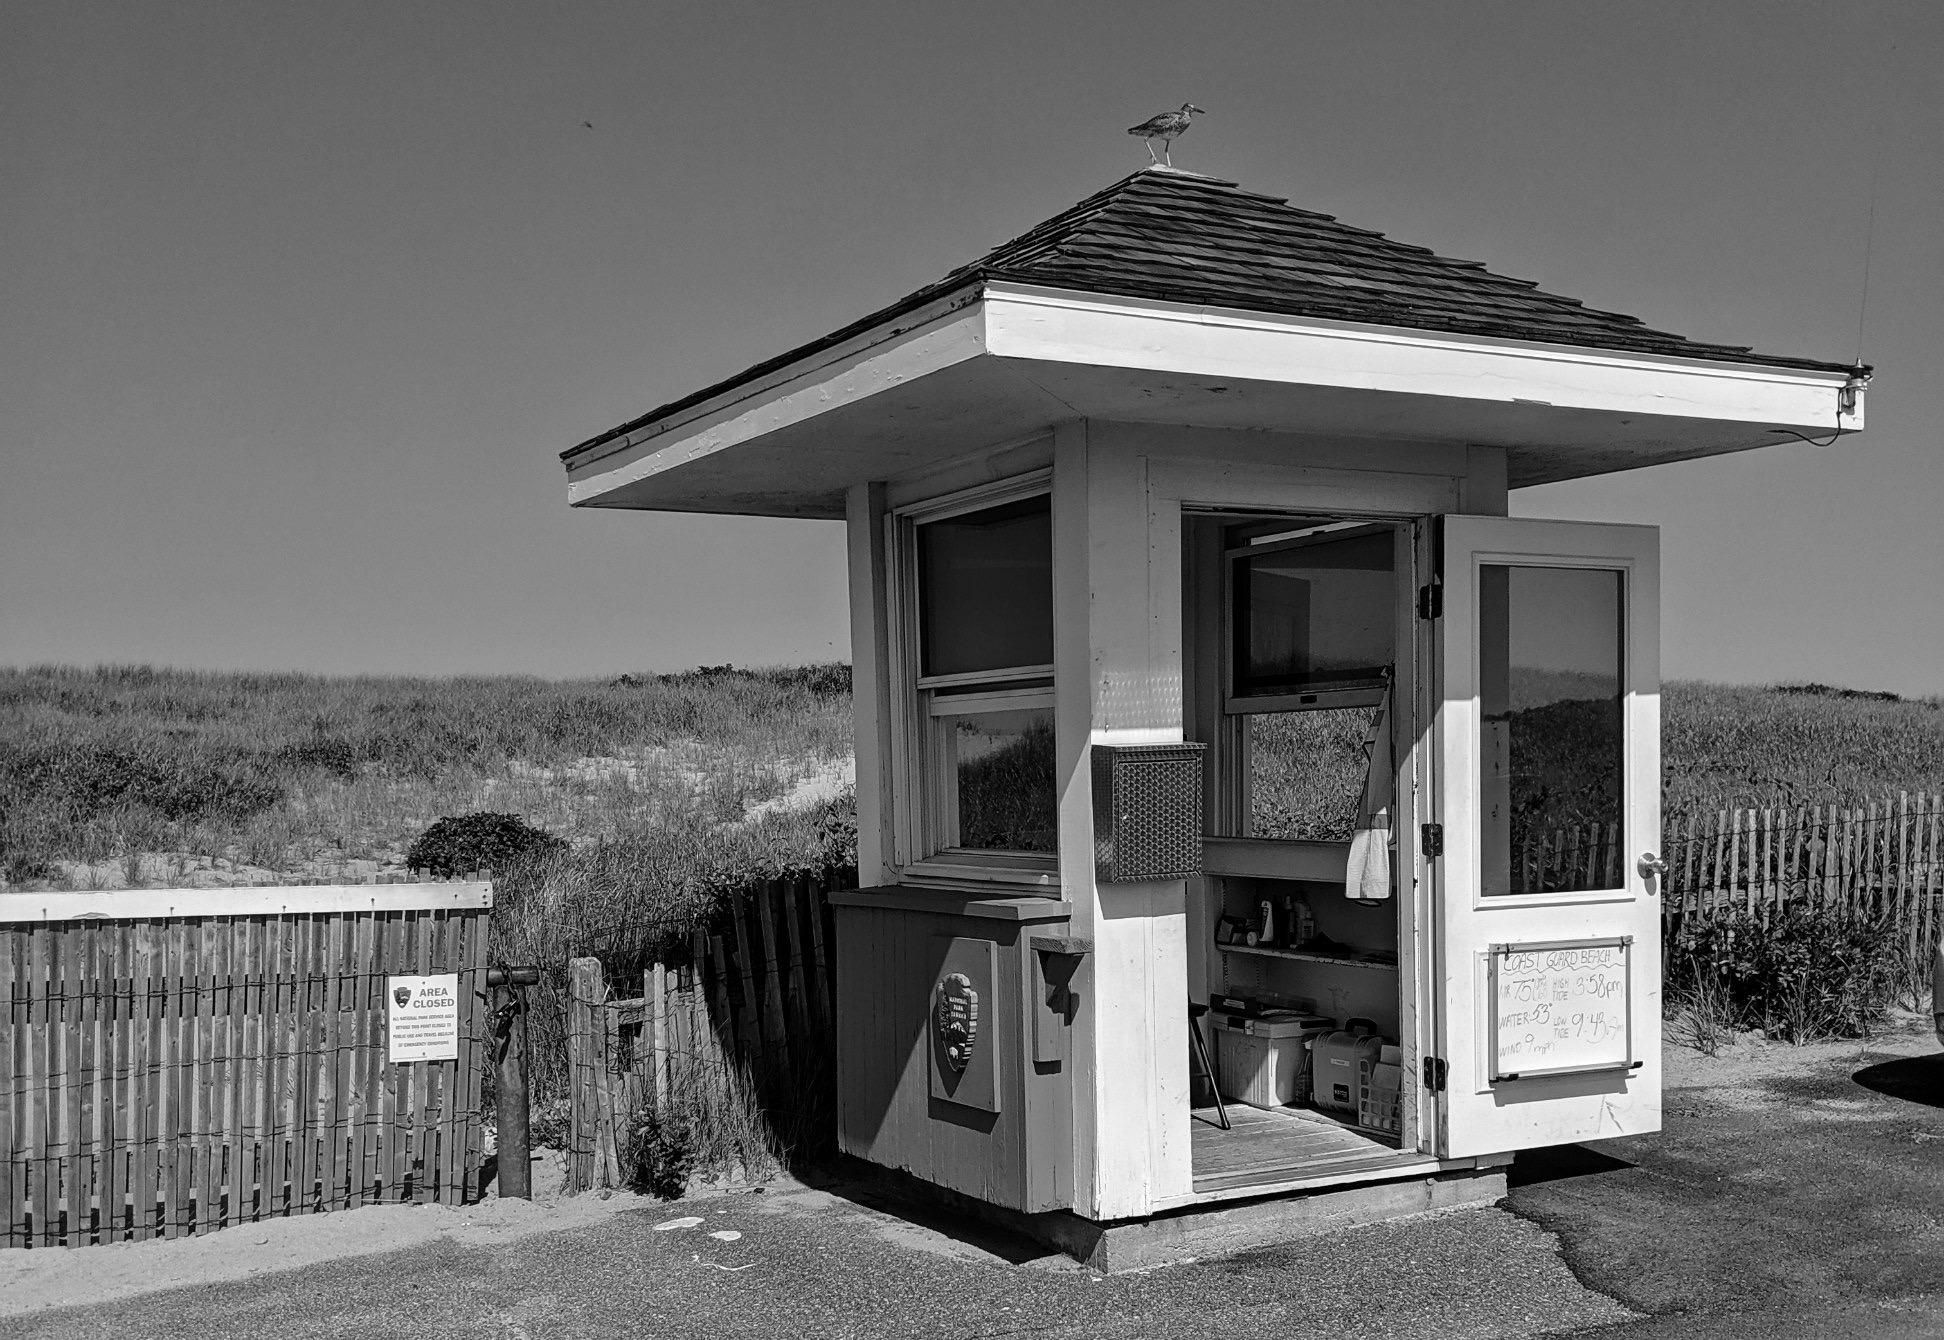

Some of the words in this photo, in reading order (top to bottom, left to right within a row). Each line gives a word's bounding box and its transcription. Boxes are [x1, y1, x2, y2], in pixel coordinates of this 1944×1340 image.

[1504, 952, 1540, 971] COAST
[1546, 951, 1578, 967] GUARD
[1581, 949, 1611, 964] BEACH
[419, 987, 449, 997] AREA
[413, 998, 455, 1009] CLOSED
